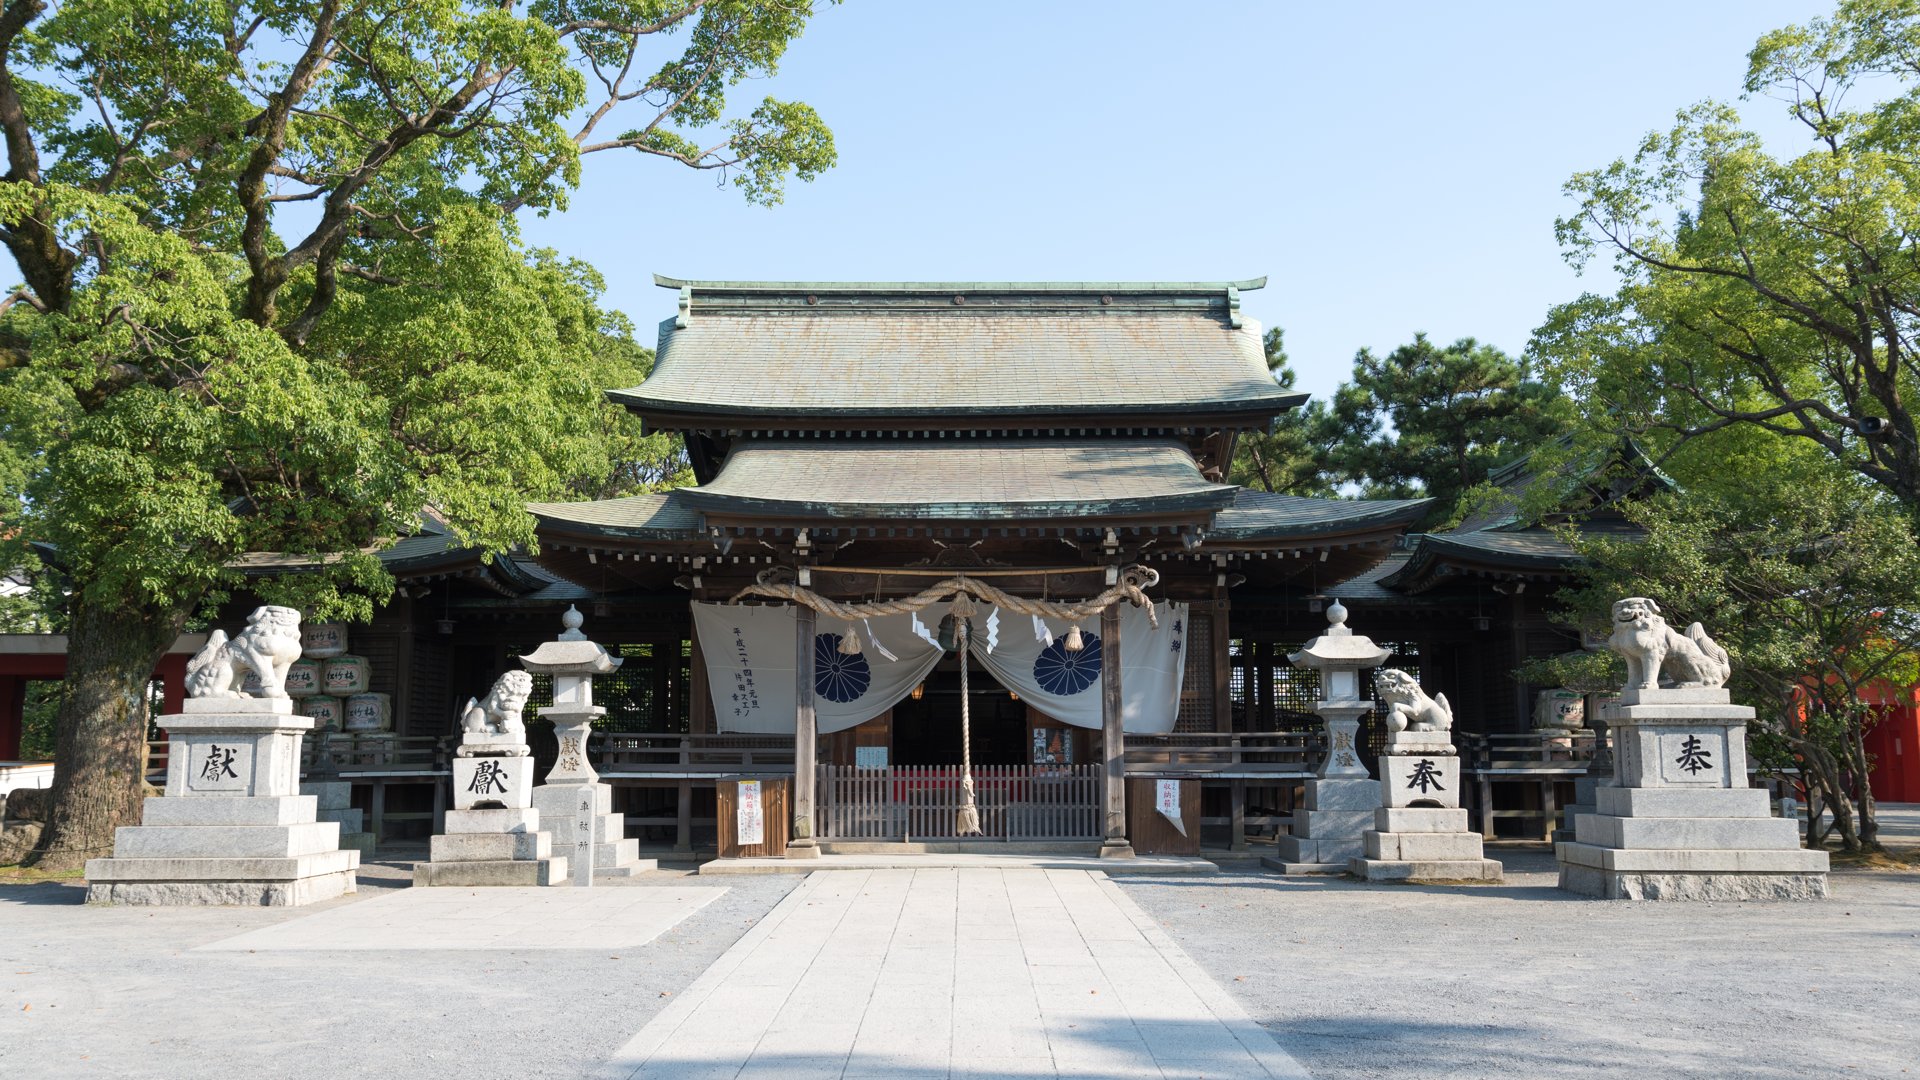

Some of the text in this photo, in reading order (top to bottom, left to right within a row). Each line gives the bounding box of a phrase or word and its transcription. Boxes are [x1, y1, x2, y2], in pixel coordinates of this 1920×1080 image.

[307, 631, 338, 642] 松竹梅
[326, 670, 354, 680] 松竹梅
[733, 627, 760, 709] 平成二十四年元旦
[1675, 734, 1713, 776] 奉
[1405, 758, 1447, 794] 奉
[578, 800, 590, 851] 車祓所
